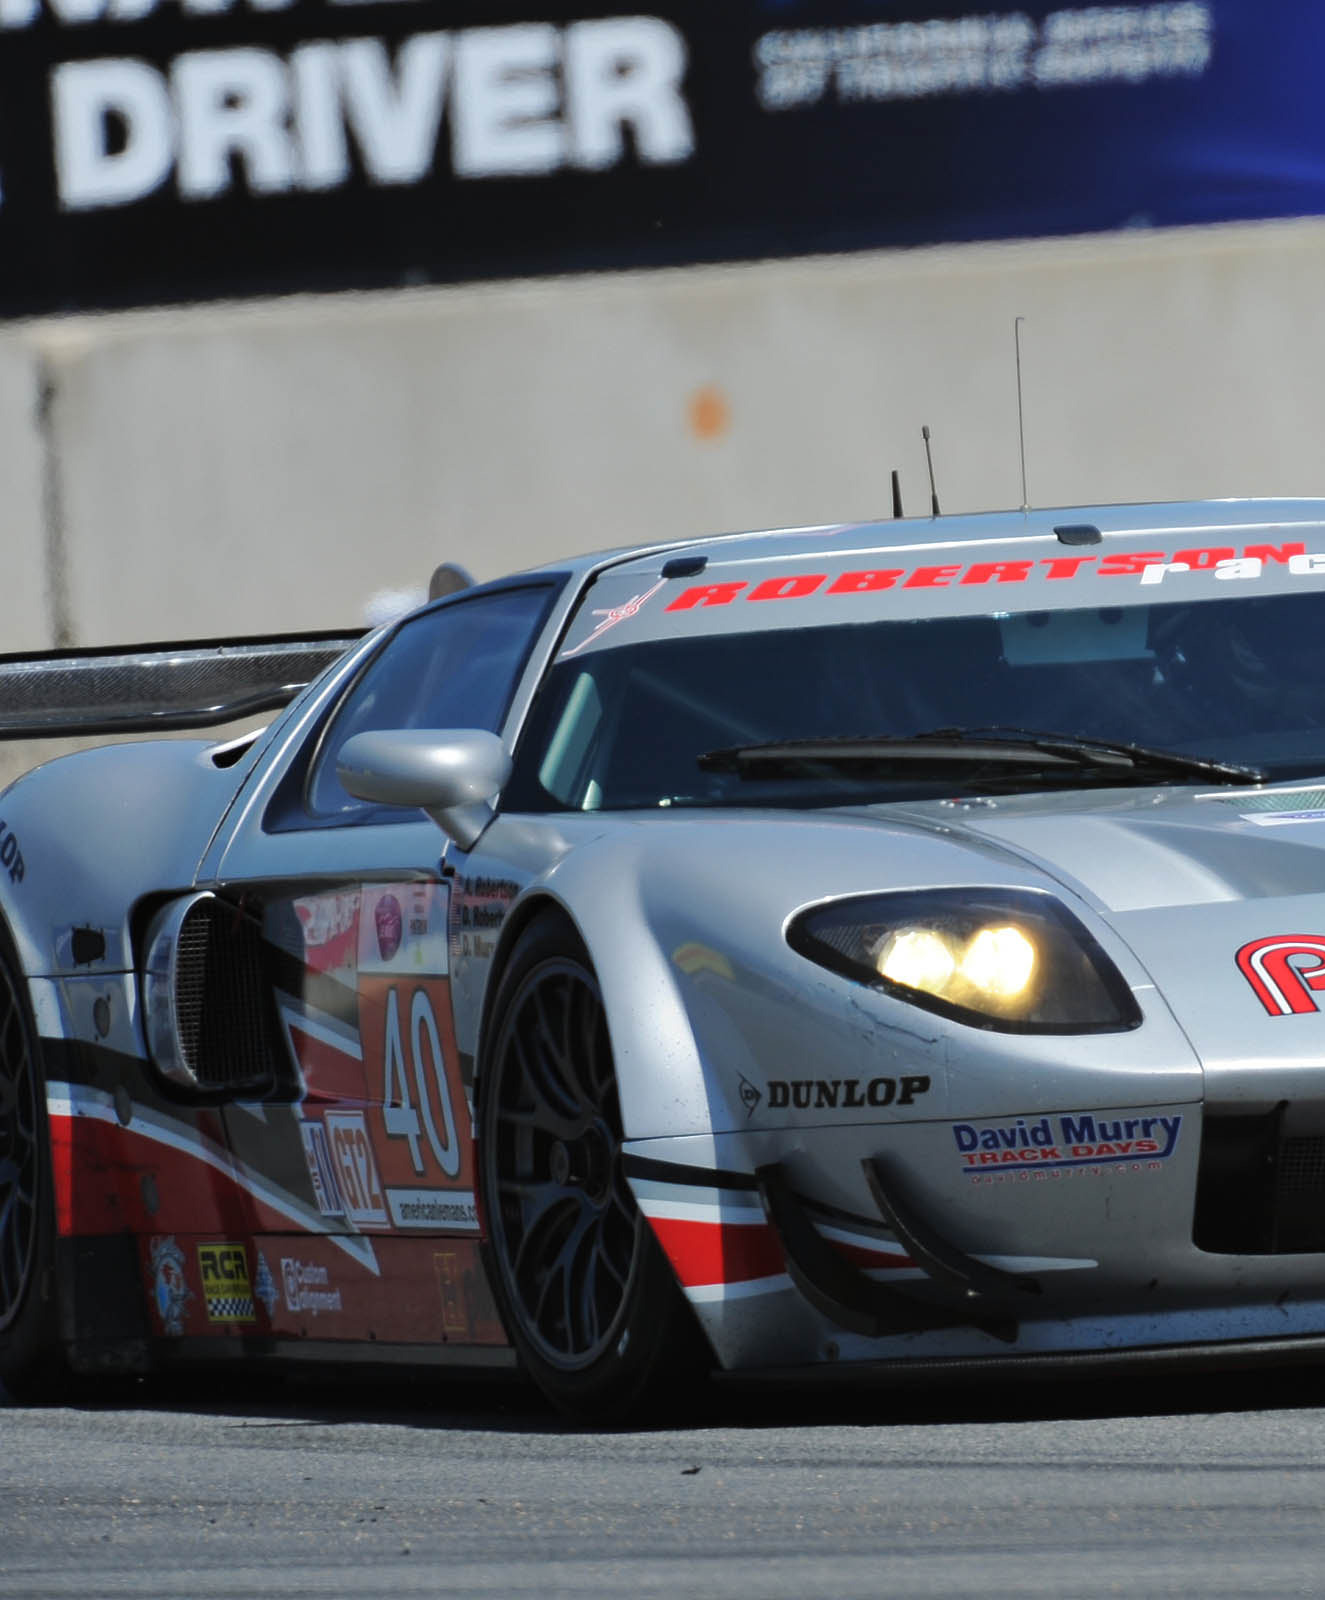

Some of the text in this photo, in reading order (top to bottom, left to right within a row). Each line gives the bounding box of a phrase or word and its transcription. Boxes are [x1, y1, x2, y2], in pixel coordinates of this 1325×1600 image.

[51, 15, 694, 211] DRIVER
[663, 542, 1306, 612] ROBERTSON
[382, 988, 460, 1177] 40
[767, 1075, 930, 1108] DUNLOP
[952, 1115, 1182, 1155] David Murry
[960, 1138, 1160, 1166] TRACK DAYS
